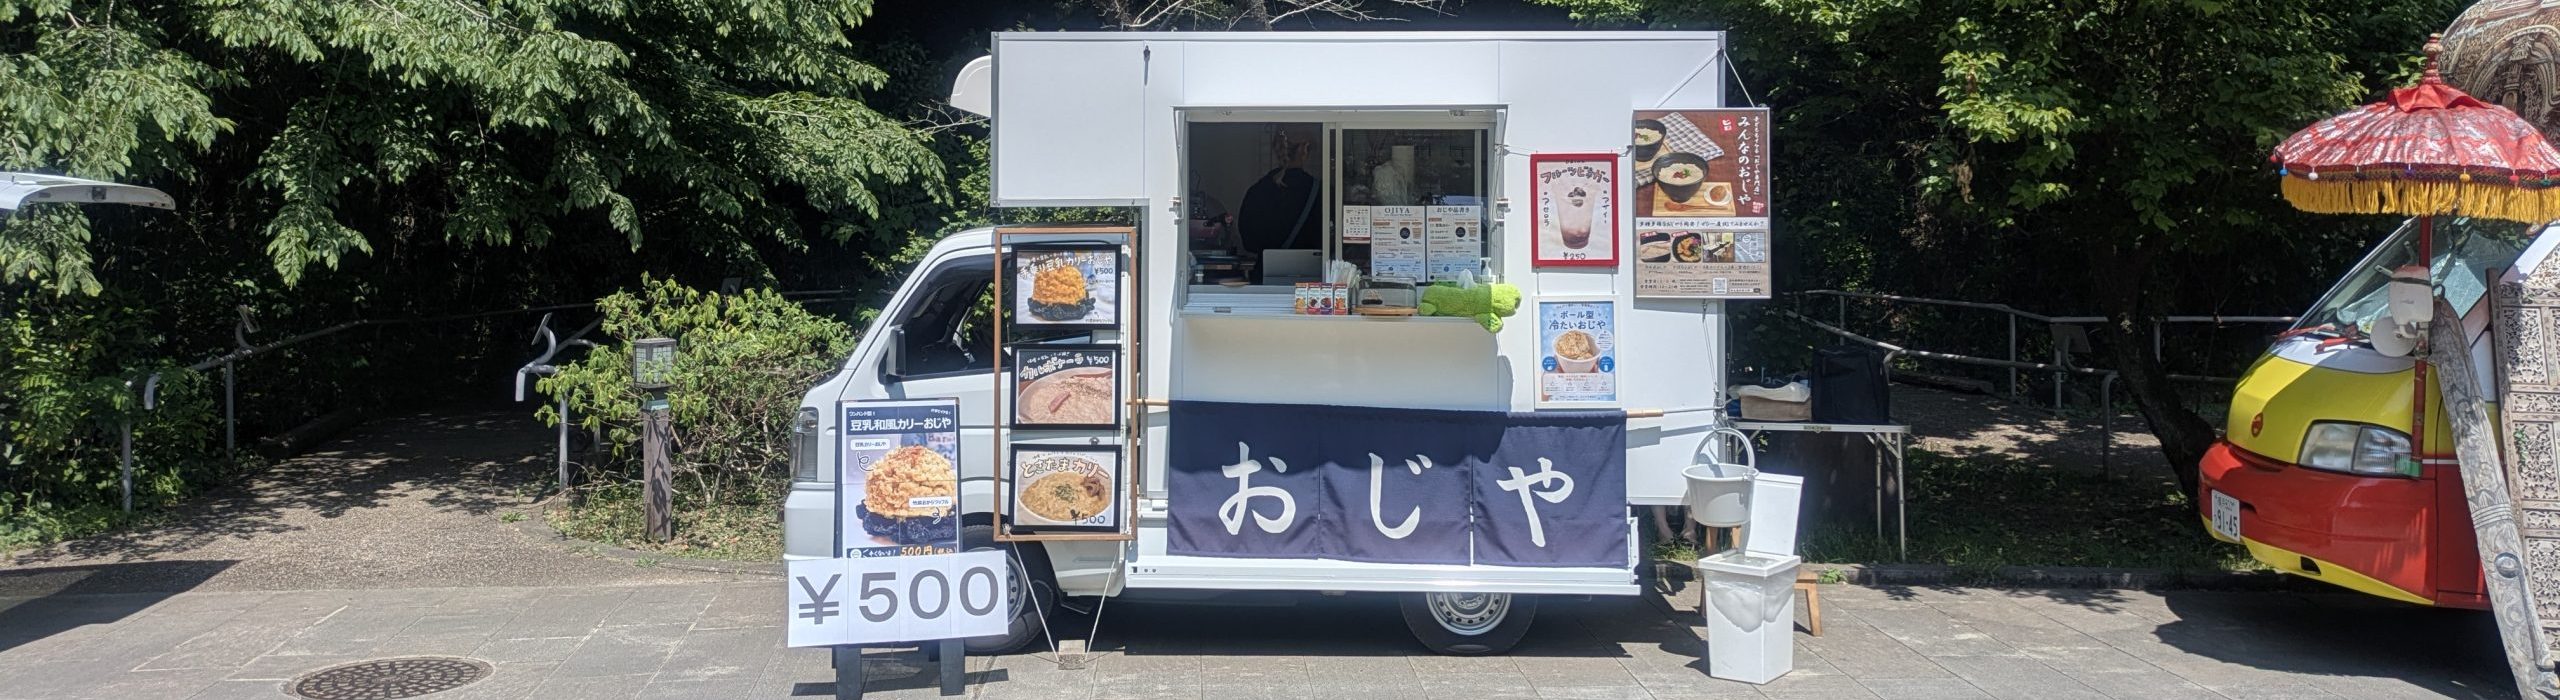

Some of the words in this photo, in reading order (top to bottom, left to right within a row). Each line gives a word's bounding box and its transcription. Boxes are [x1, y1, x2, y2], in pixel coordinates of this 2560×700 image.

[1738, 116, 1751, 205] みんなのおじや
[1540, 165, 1610, 185] フルーツビネガー
[1563, 252, 1586, 260] ¥250
[1094, 267, 1113, 275] ¥500
[1560, 310, 1595, 320] ボール型
[1549, 320, 1607, 330] 冷たいおじや
[1086, 355, 1110, 366] ¥500
[850, 417, 952, 431] 豆乳和風カリーおじや
[1219, 442, 1574, 547] おじや
[1070, 509, 1106, 525] ¥500
[796, 566, 999, 625] ¥500
